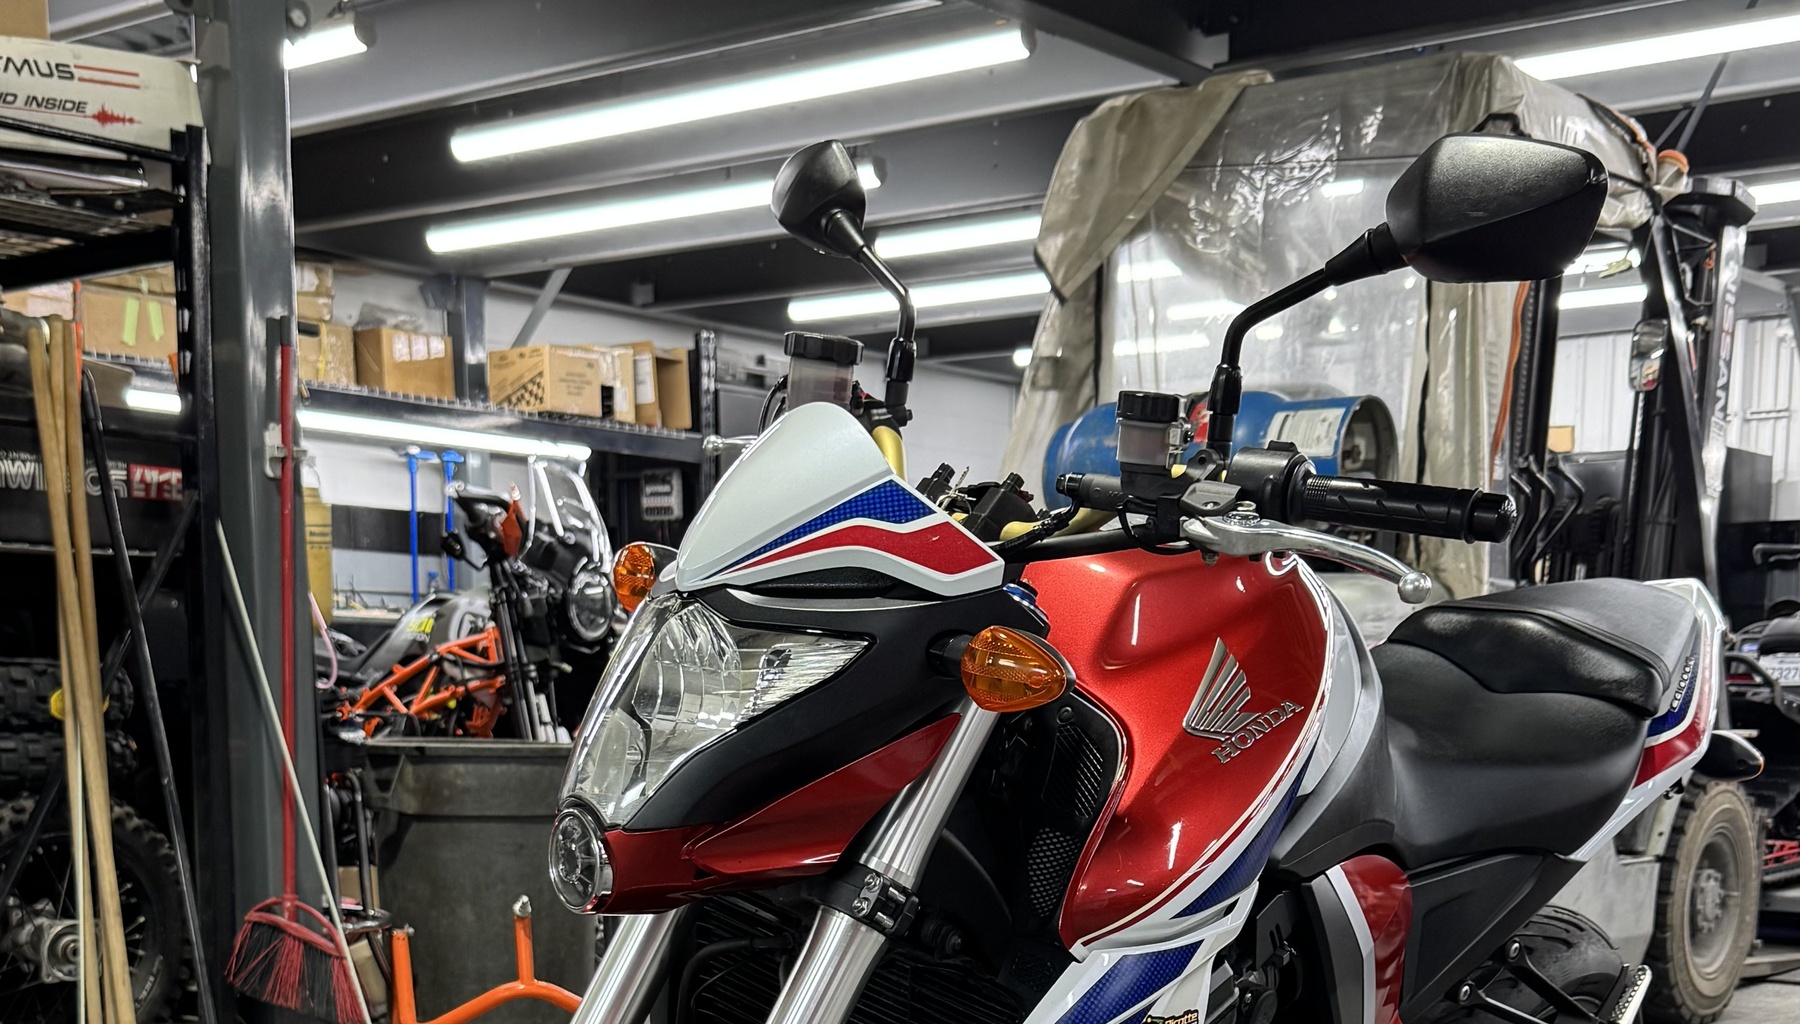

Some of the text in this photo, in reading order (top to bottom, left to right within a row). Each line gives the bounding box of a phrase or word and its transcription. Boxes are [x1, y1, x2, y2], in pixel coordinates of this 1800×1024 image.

[0, 56, 75, 81] MUS
[24, 95, 89, 114] INSIDE
[1211, 701, 1304, 763] HONDA
